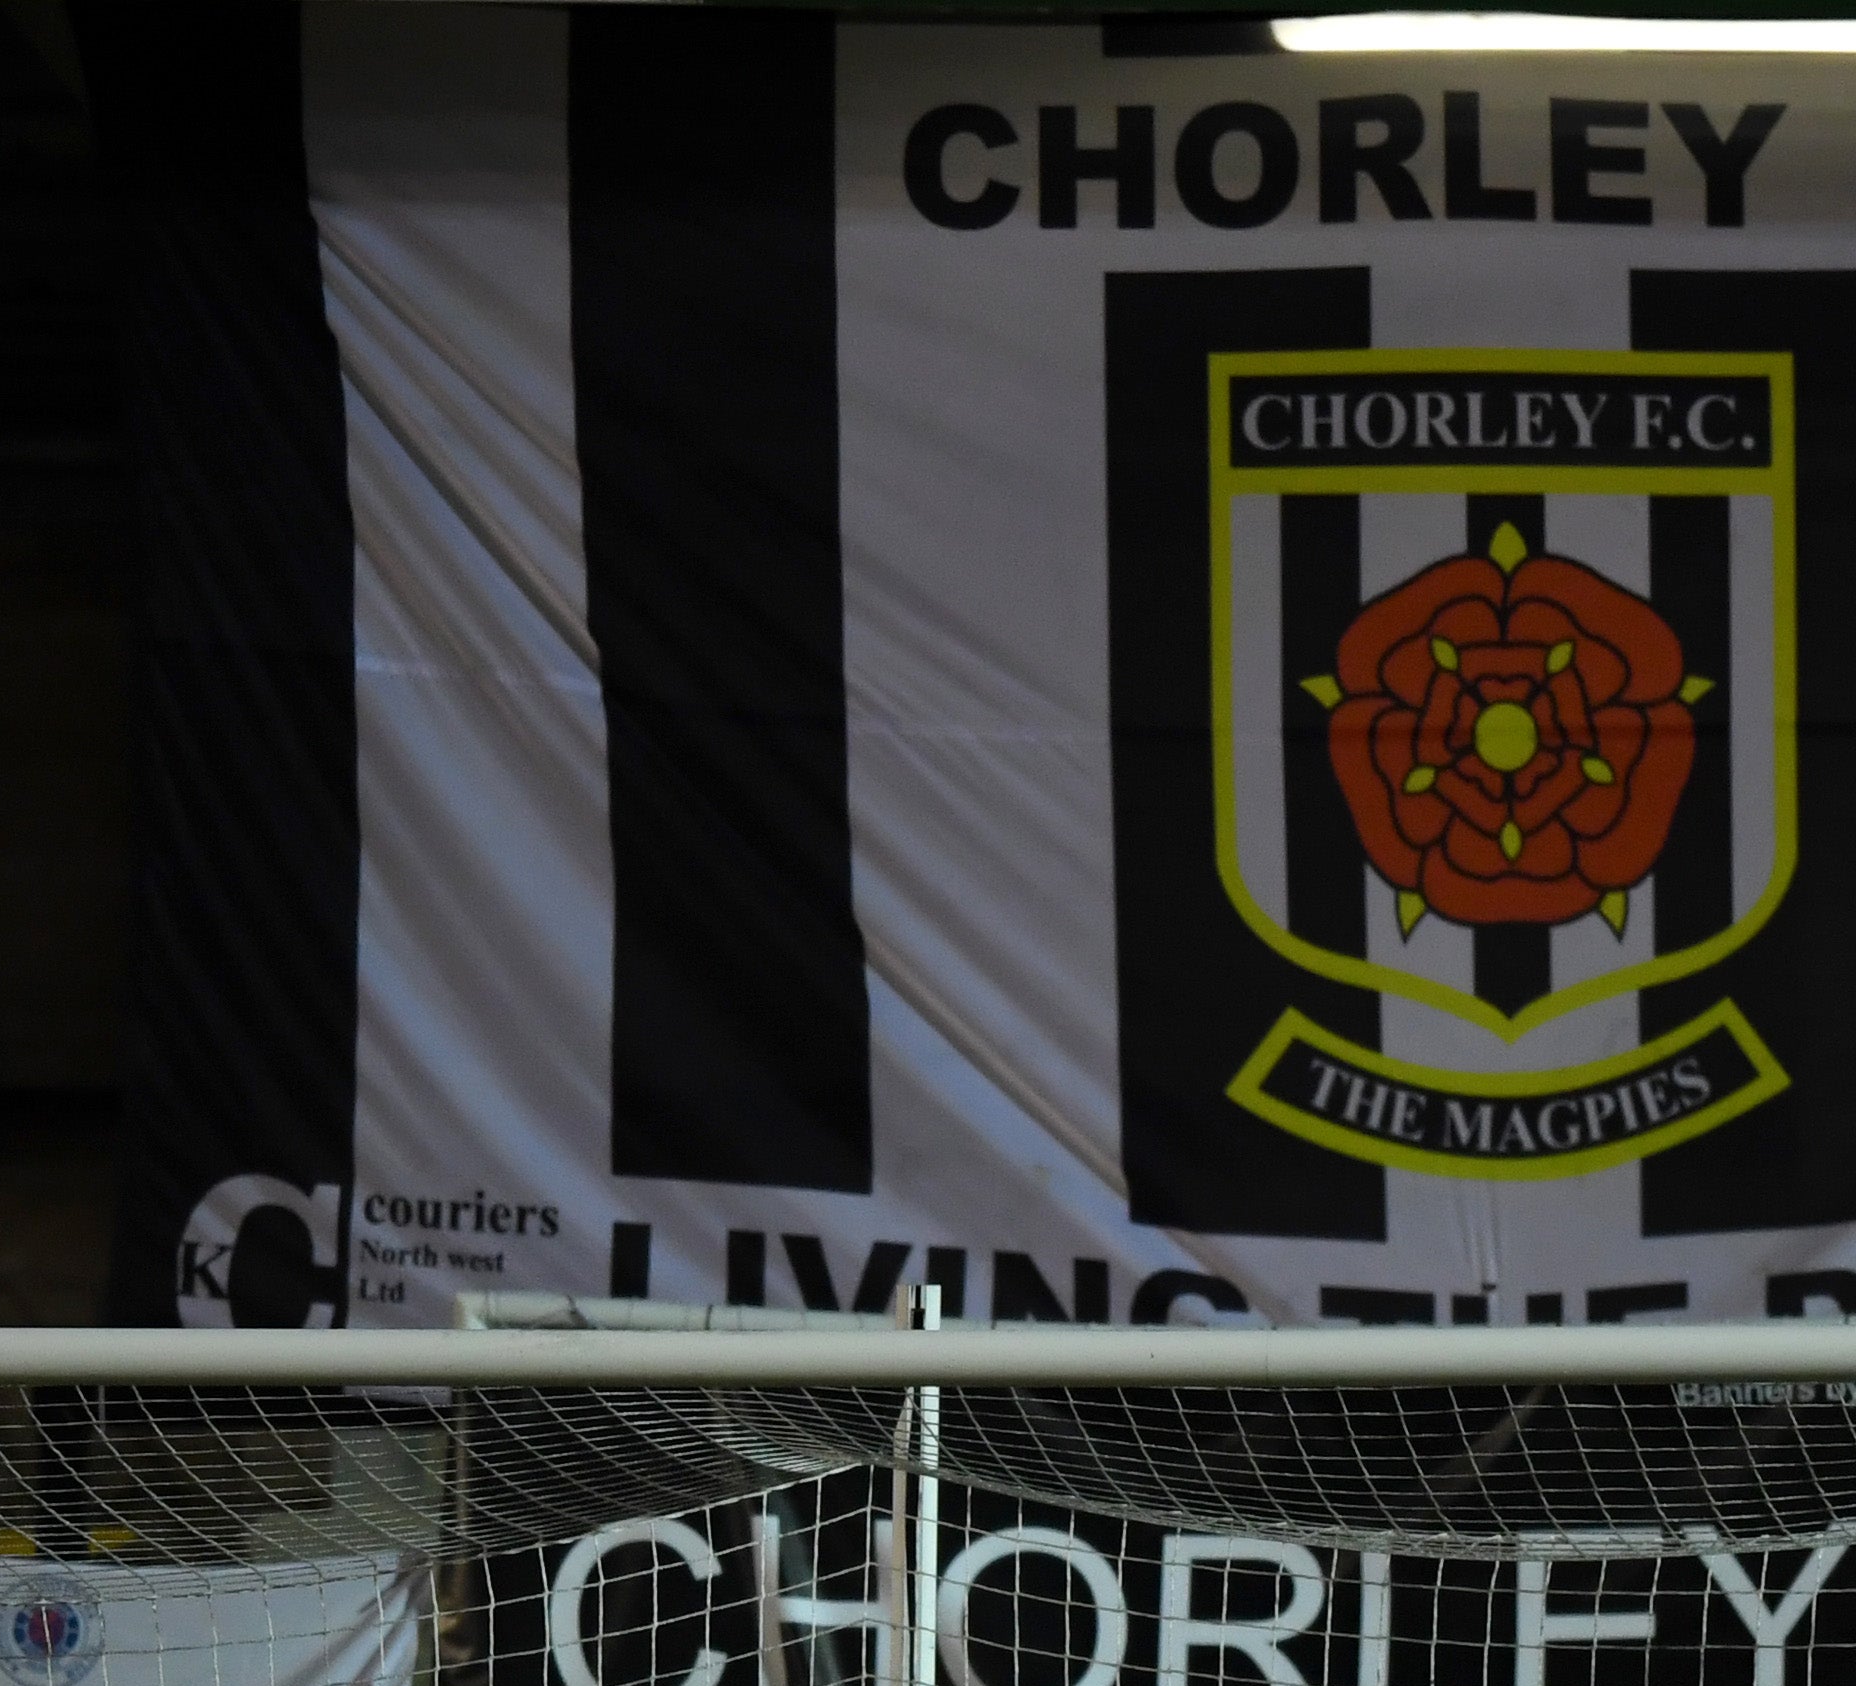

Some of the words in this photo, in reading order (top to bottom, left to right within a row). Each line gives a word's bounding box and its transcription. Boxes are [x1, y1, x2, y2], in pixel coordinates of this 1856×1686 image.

[903, 91, 1787, 231] CHORLEY
[1241, 391, 1609, 452] CHORLEY
[1632, 392, 1757, 452] F.C.
[1306, 1057, 1428, 1143] THE
[1443, 1055, 1714, 1155] MAGPIES
[363, 1190, 560, 1237] couriers
[359, 1239, 439, 1271] North
[446, 1250, 505, 1274] west
[359, 1278, 405, 1303] Ltd
